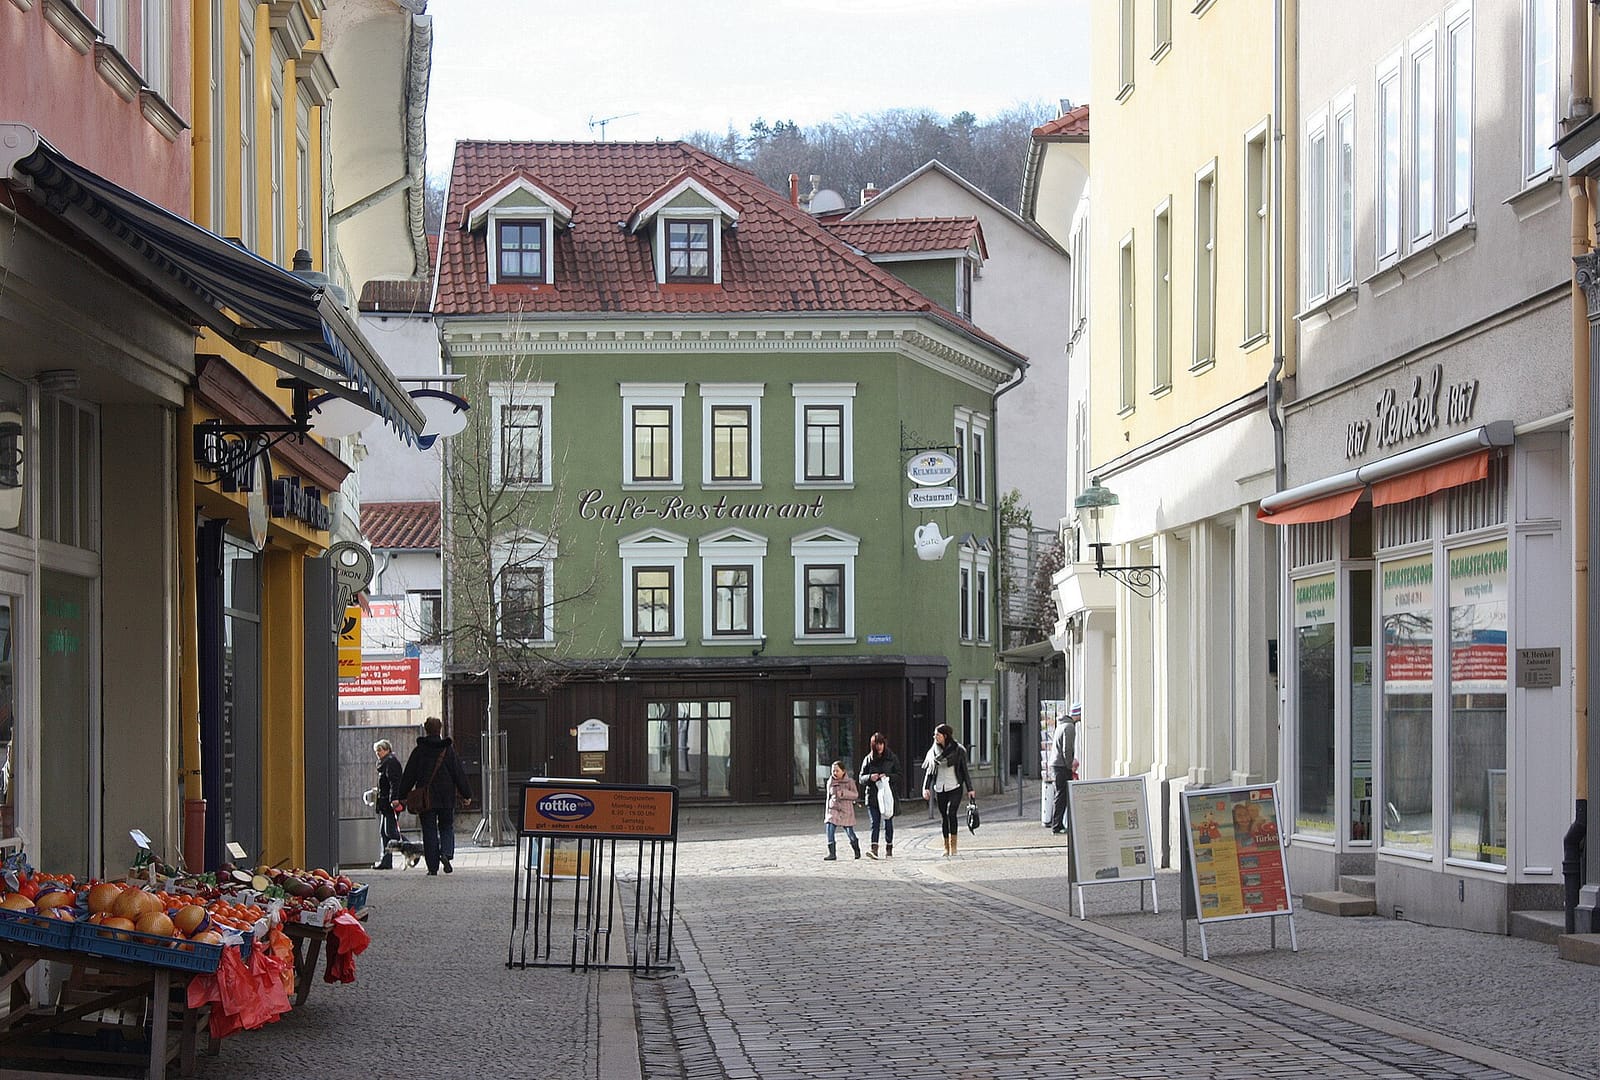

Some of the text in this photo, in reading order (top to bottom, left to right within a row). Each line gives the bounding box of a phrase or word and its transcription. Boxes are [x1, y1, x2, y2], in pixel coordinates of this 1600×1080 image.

[1345, 363, 1479, 460] 1867 Henkel 1867
[913, 493, 953, 502] Restaurant
[577, 488, 826, 527] Café-Restaurant
[381, 664, 411, 672] Wohnungen
[539, 801, 577, 812] rottke
